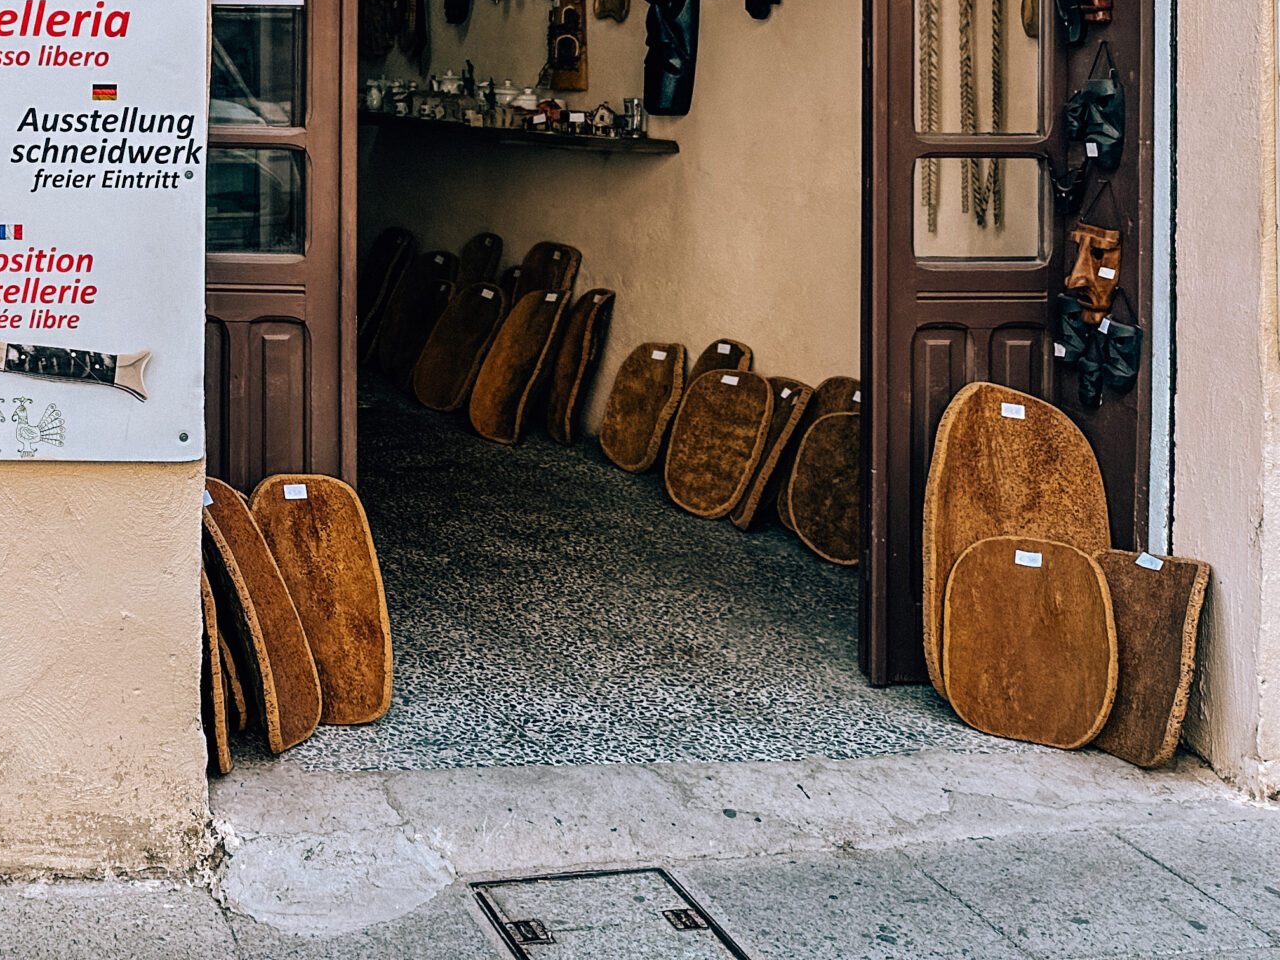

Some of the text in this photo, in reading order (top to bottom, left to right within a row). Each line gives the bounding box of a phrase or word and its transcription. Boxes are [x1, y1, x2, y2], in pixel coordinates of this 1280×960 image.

[38, 46, 110, 67] libero
[18, 107, 195, 139] Ausstellung
[10, 138, 203, 165] schneidwerk
[31, 169, 181, 192] freier Eintritt
[28, 309, 80, 329] libre
